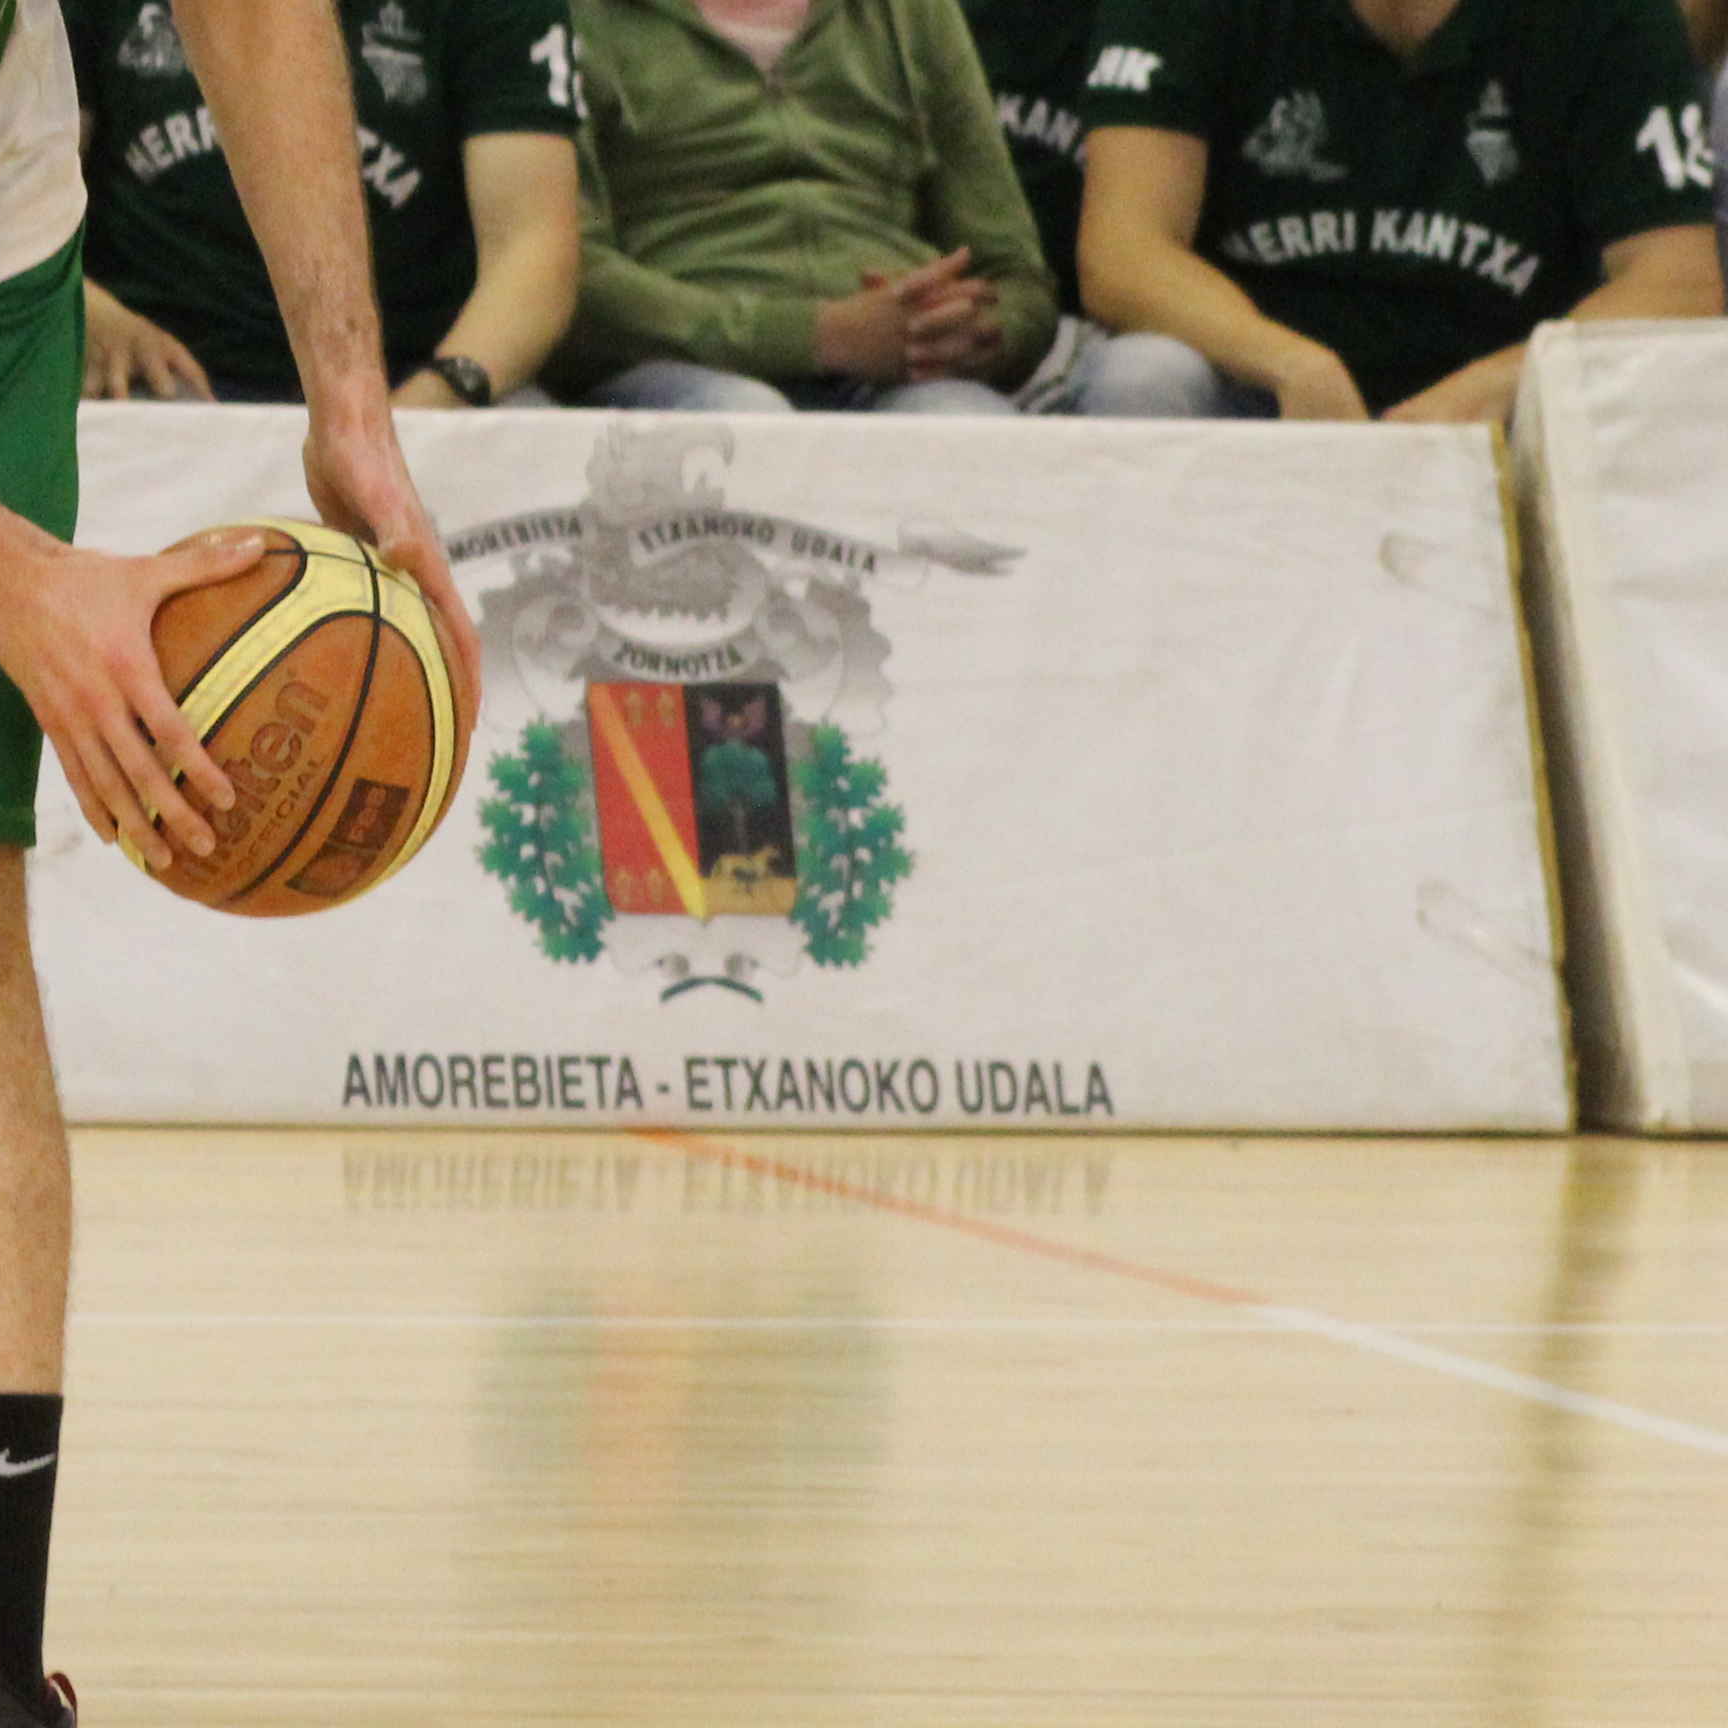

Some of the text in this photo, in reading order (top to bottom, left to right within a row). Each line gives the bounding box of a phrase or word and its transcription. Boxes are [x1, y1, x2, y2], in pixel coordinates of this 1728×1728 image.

[124, 106, 224, 183] HERR
[1370, 208, 1540, 297] KANTXA
[446, 514, 583, 566] MOREBIETA
[791, 529, 877, 575] UDALA
[236, 756, 328, 873] OFFICIAL
[343, 1052, 644, 1110] AMOREBIETA
[685, 1056, 940, 1115] ETXANOKO
[956, 1059, 1115, 1117] UDALA
